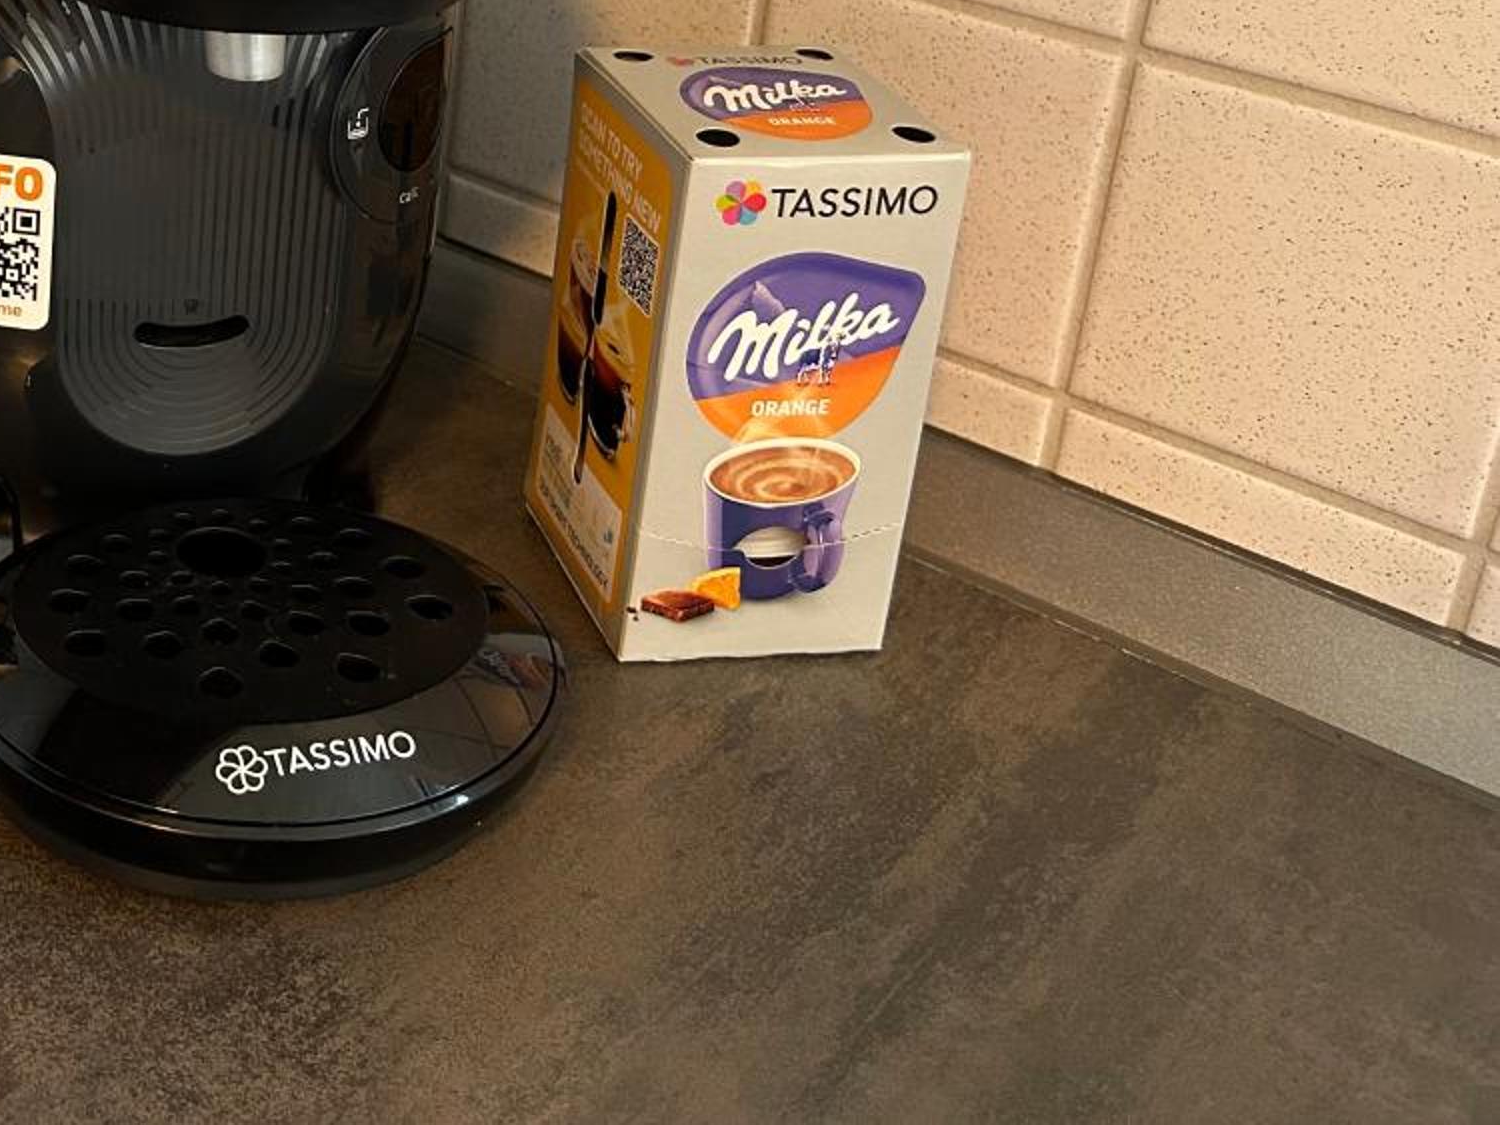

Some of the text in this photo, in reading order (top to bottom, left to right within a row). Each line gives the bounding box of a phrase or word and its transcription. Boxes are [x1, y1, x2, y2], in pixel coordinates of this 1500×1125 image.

[703, 79, 848, 113] Milka
[767, 116, 837, 126] ORANGE
[771, 184, 939, 219] TASSIMO
[707, 292, 901, 382] Milka
[751, 398, 831, 417] ORANGE
[263, 730, 417, 777] TASSIMO
